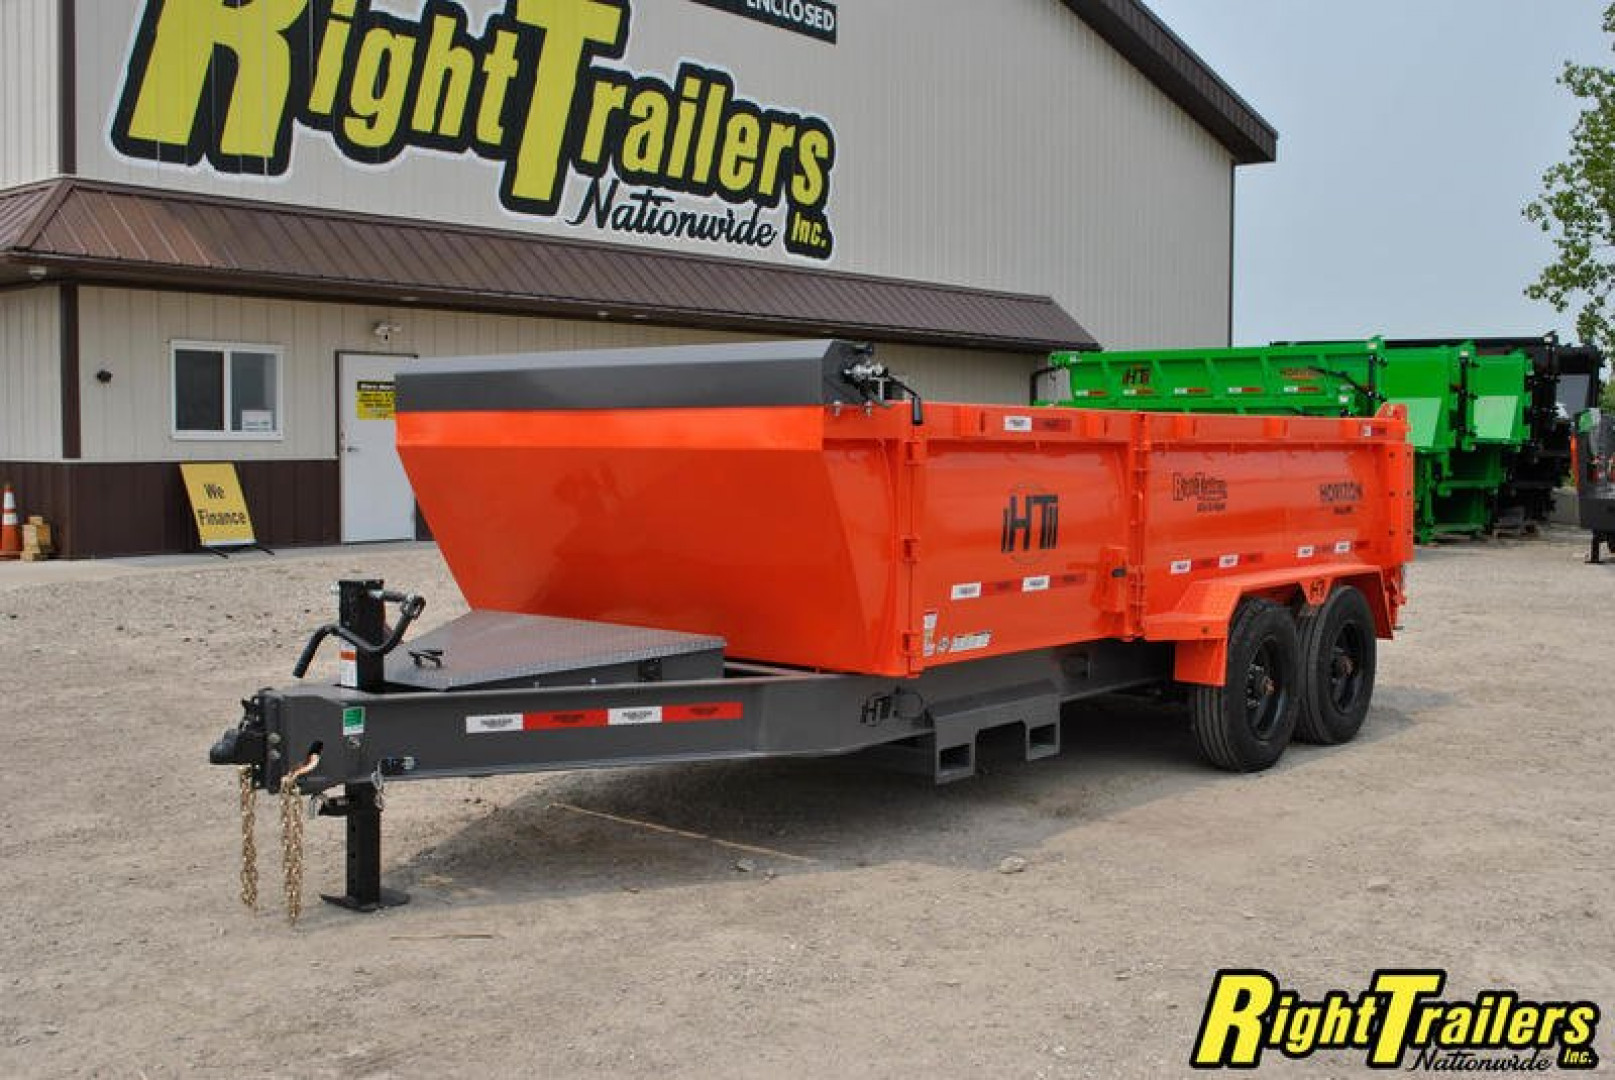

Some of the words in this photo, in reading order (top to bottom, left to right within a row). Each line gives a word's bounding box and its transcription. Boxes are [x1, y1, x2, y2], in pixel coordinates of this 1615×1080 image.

[565, 176, 778, 248] Nationwide
[790, 211, 829, 248] Inc.
[203, 483, 225, 499] We
[198, 508, 247, 527] Finance
